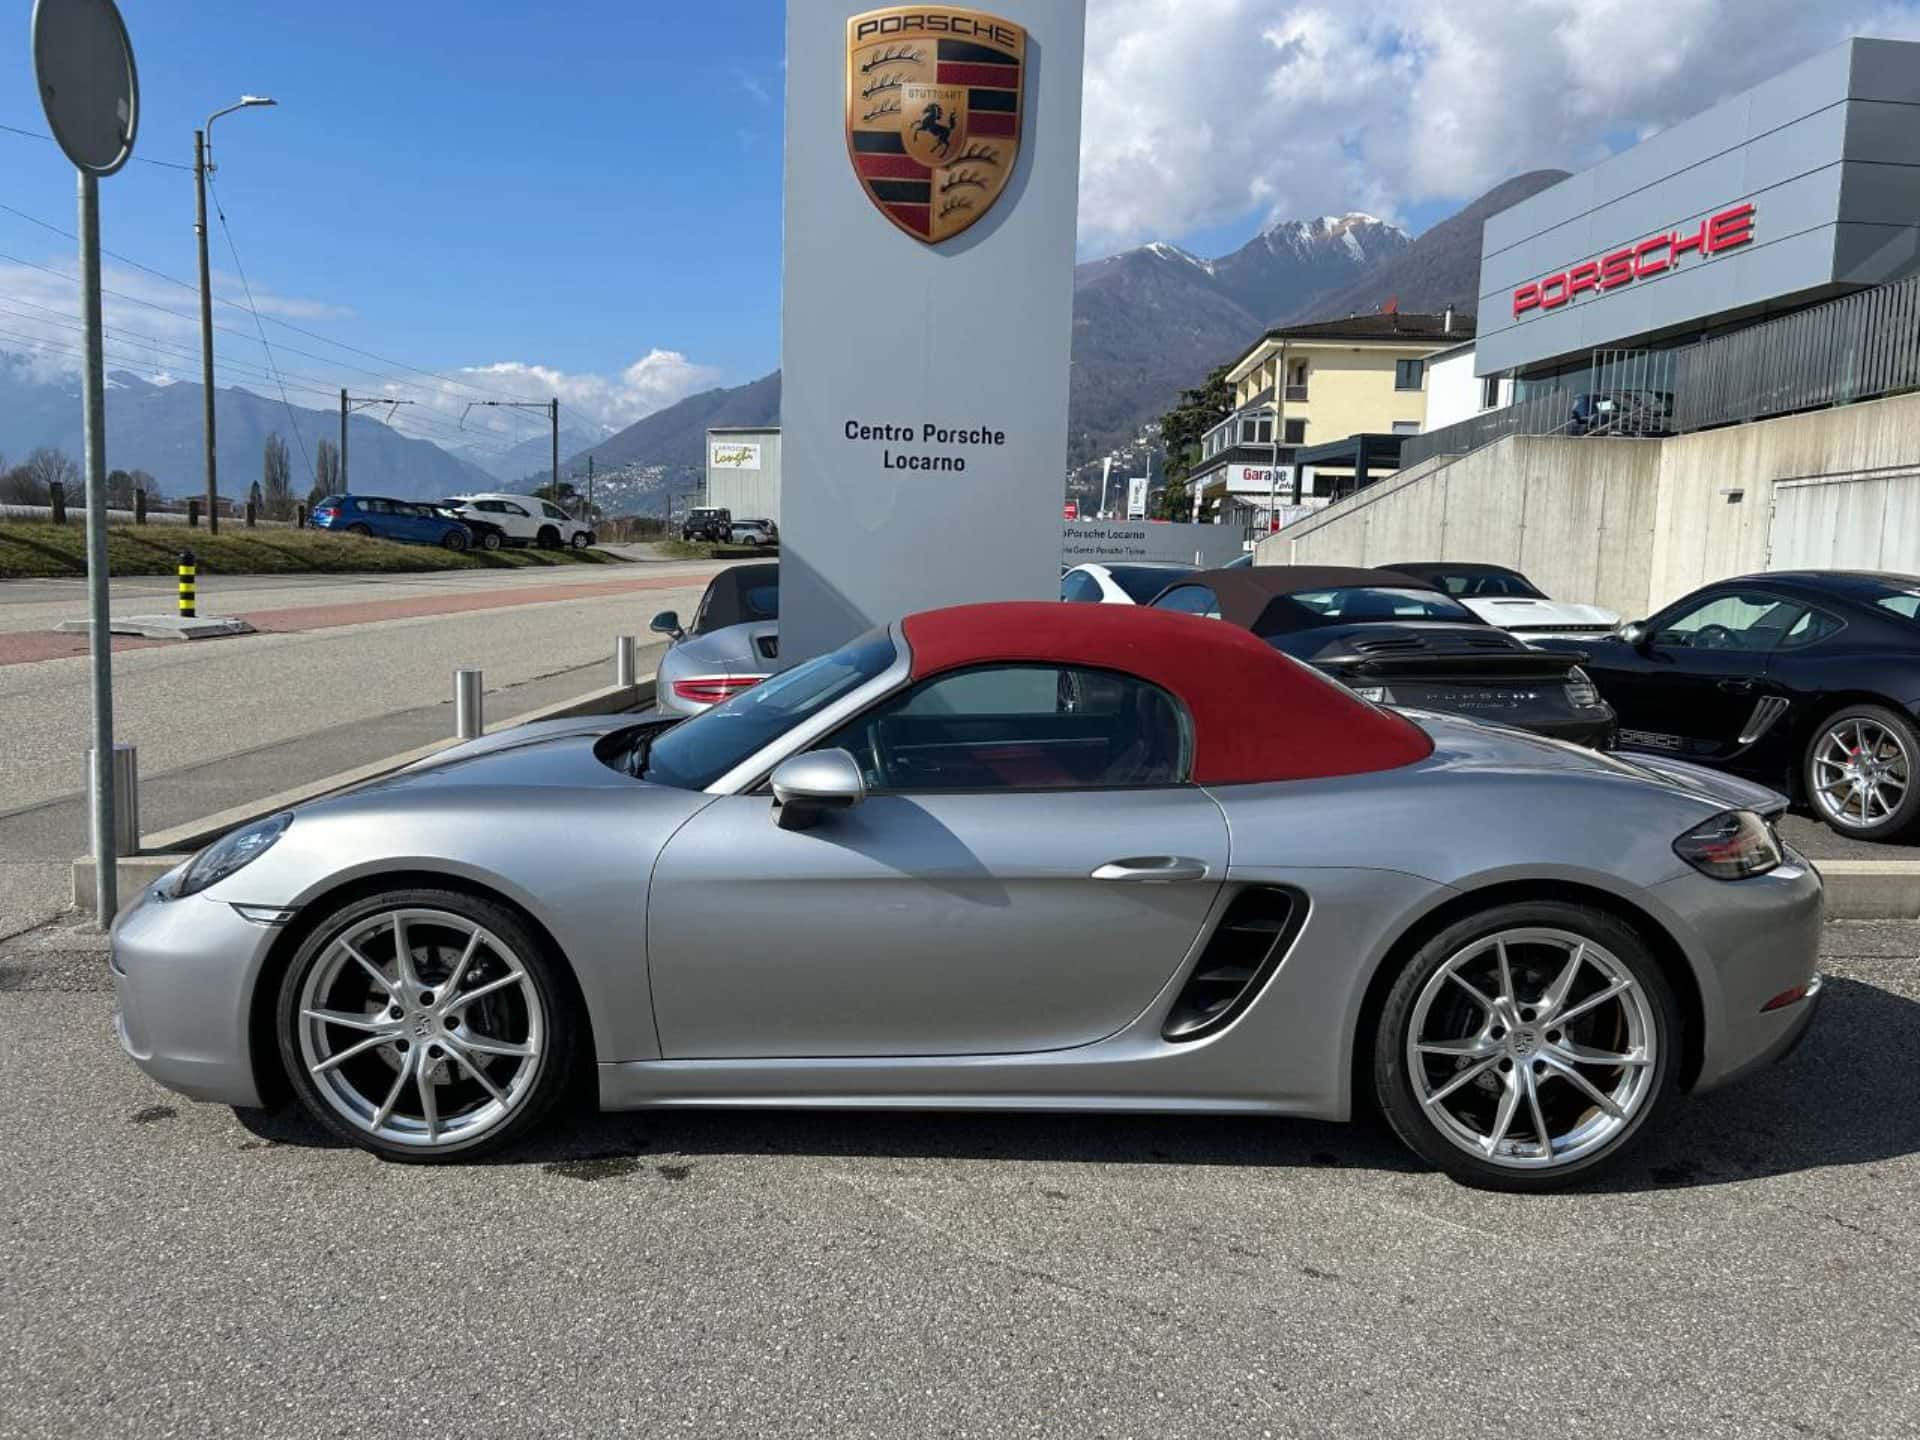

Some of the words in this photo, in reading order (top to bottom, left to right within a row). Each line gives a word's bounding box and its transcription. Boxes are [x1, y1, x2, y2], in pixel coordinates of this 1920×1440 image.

[857, 14, 1015, 48] PORSCHE
[1513, 203, 1756, 321] PORSCHE
[845, 420, 914, 442] Centro
[923, 423, 1005, 446] Porsche
[884, 450, 966, 472] Locarno
[1243, 467, 1287, 485] Garage
[1067, 528, 1106, 540] Porsche
[1107, 529, 1145, 540] Locarno
